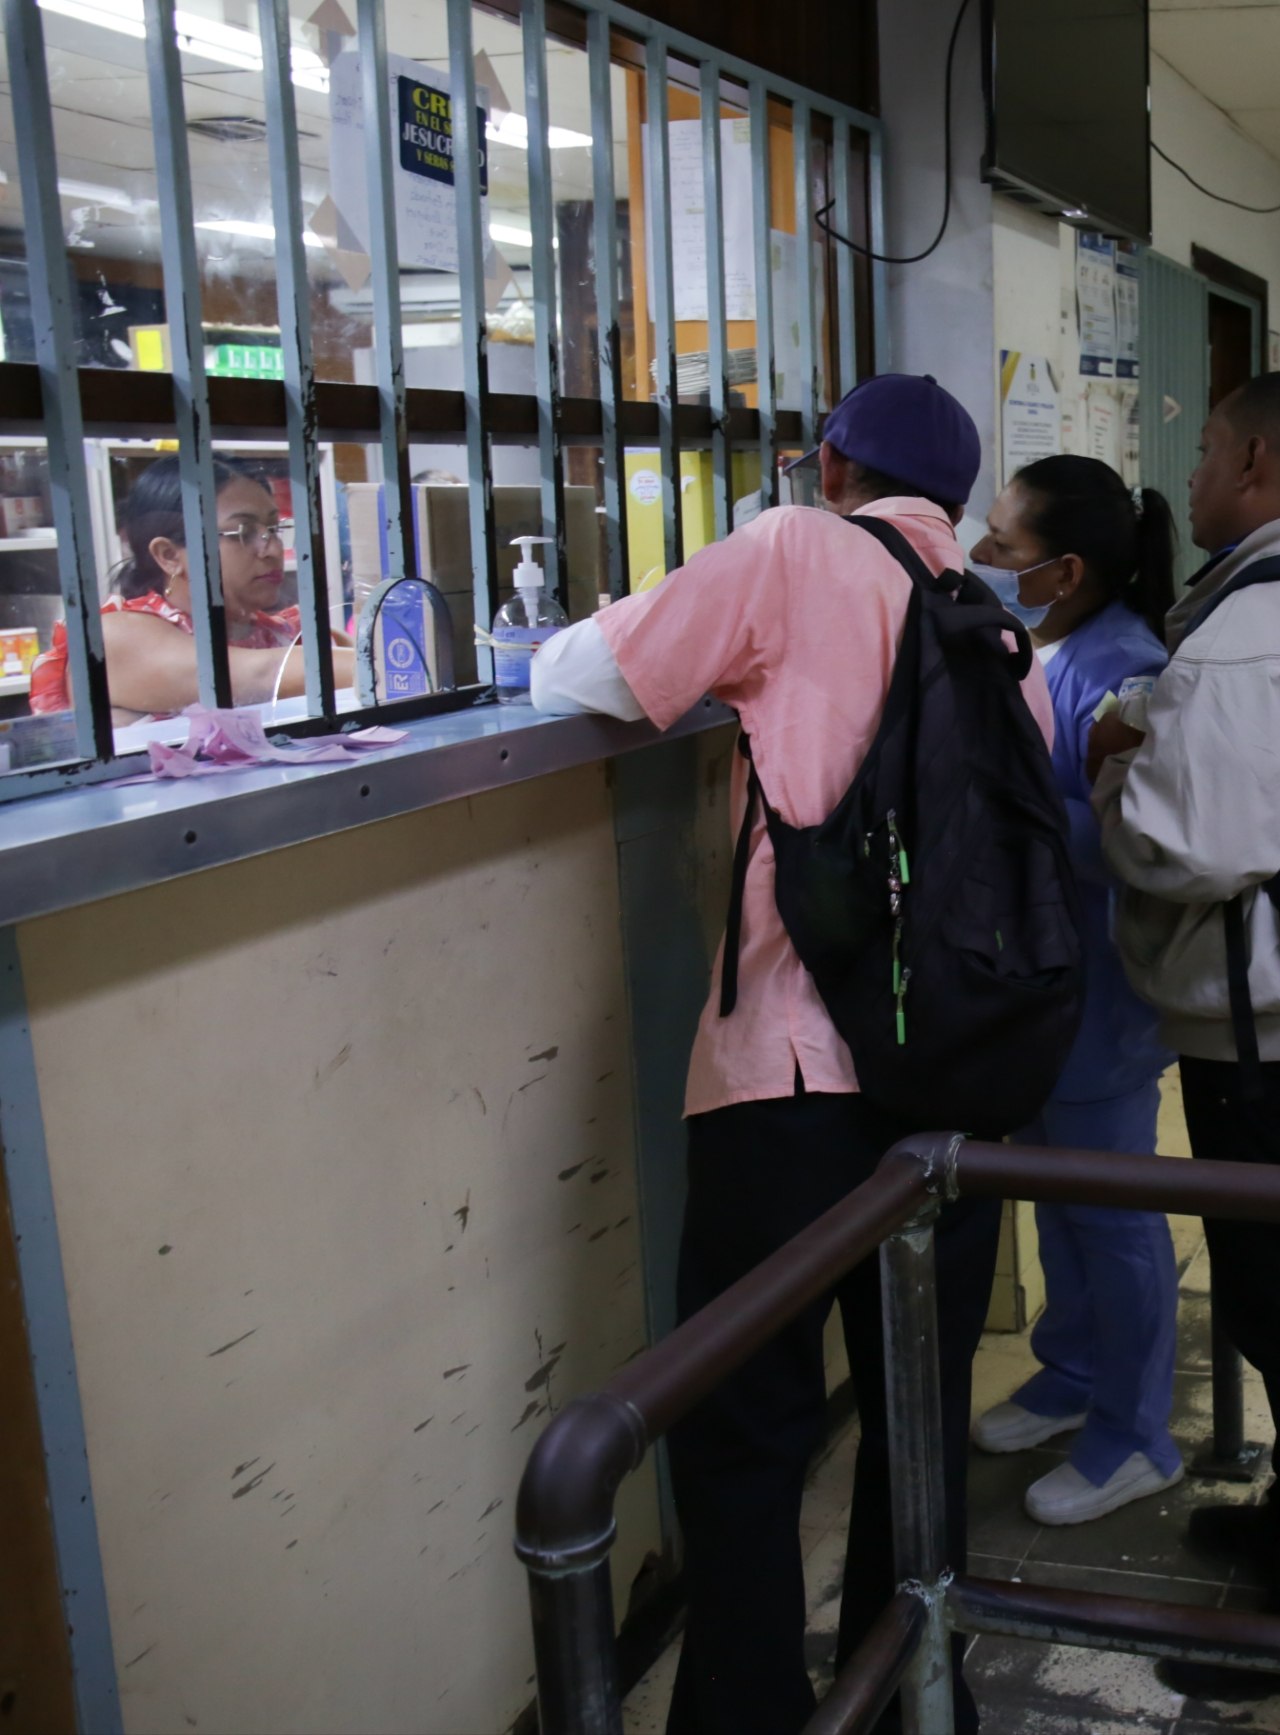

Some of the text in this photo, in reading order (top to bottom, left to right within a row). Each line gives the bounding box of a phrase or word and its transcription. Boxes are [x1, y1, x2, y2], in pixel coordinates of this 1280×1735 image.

[415, 110, 428, 127] EN
[430, 116, 441, 131] EL
[416, 149, 423, 161] Y
